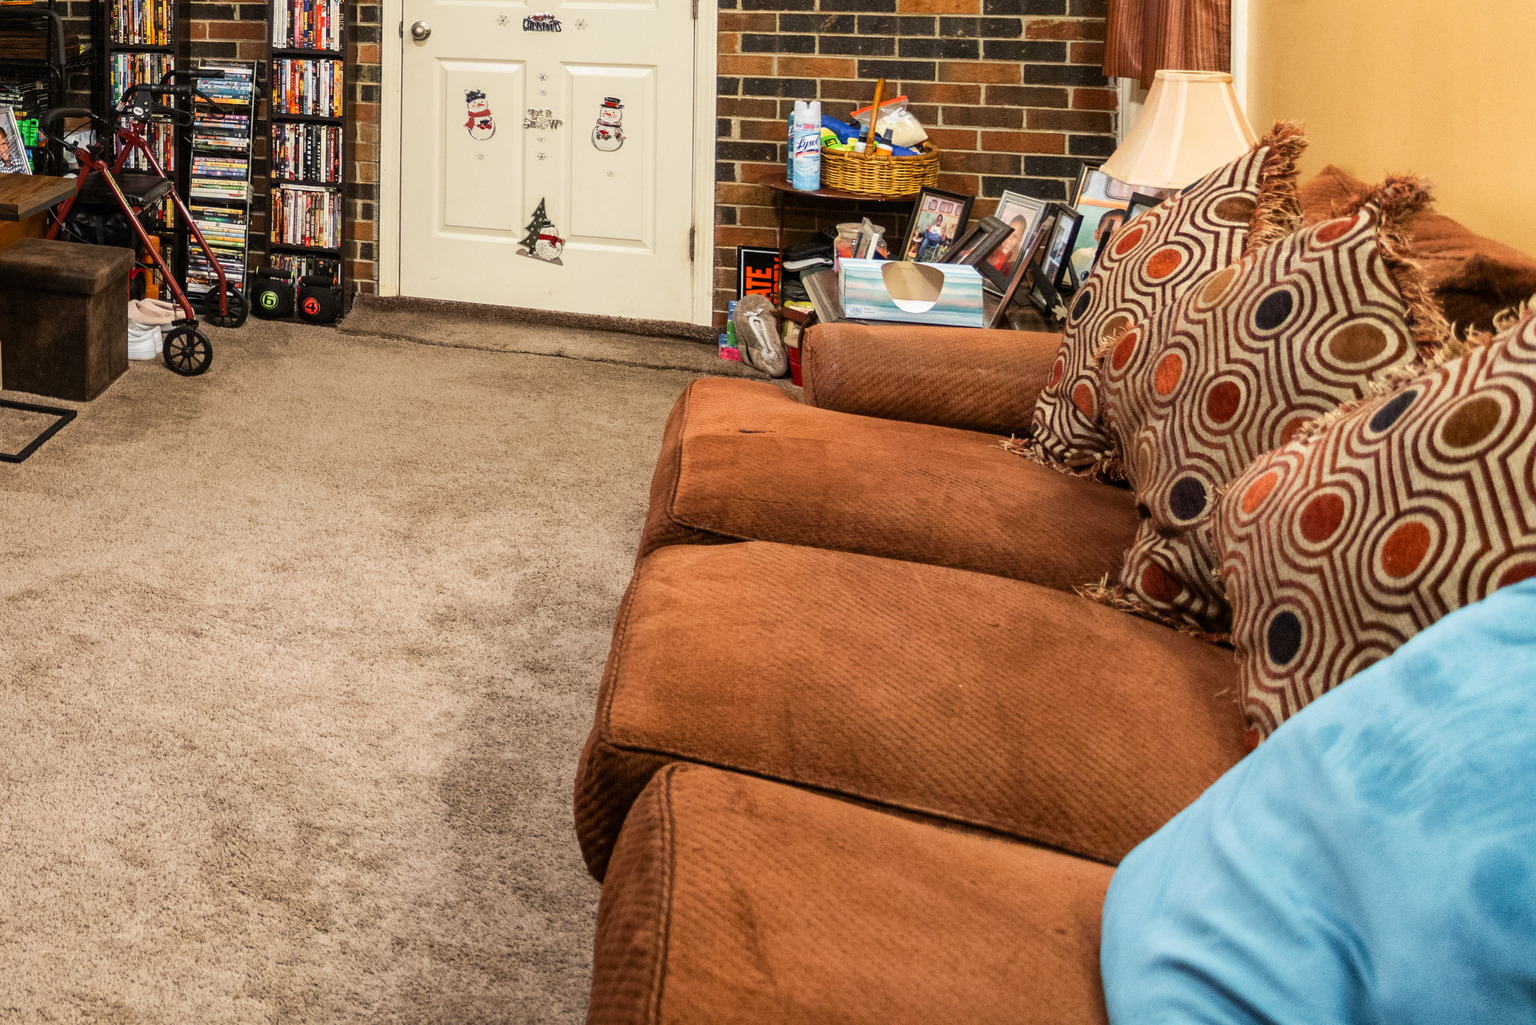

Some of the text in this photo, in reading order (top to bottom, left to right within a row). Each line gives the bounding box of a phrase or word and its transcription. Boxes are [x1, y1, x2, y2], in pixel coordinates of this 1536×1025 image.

[795, 137, 820, 152] Lysol
[745, 266, 772, 302] ATE
[264, 295, 274, 305] 6
[305, 301, 316, 312] 4
